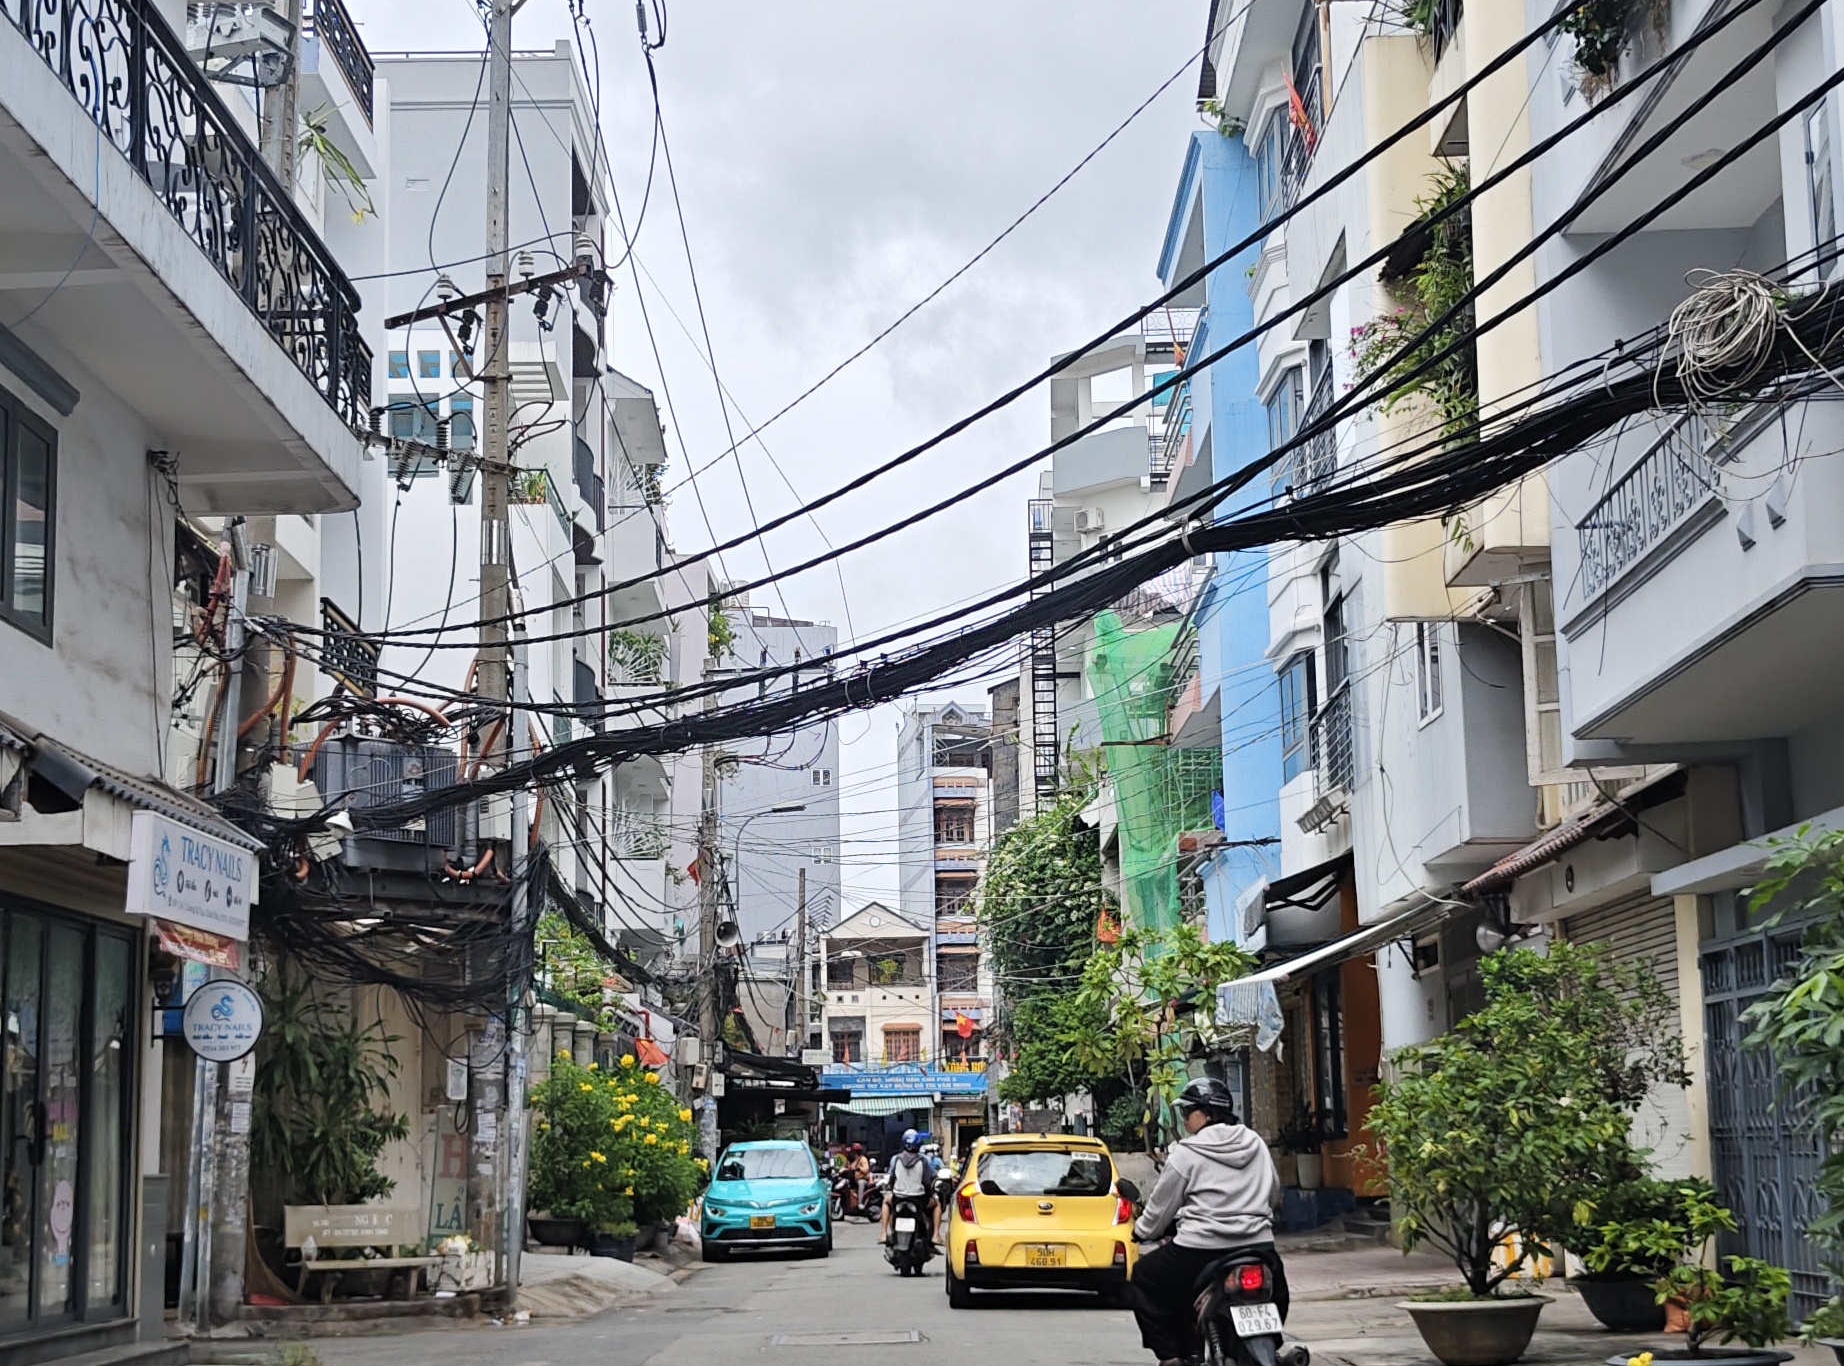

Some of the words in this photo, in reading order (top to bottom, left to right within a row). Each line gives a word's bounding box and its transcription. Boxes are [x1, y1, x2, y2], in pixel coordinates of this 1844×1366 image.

[181, 835, 214, 872] TRACY
[215, 849, 243, 883] NAILS
[192, 1023, 223, 1032] TRACY
[225, 1023, 253, 1031] NAILS
[1239, 1305, 1272, 1319] 60-F4
[1238, 1317, 1278, 1333] 029.67
